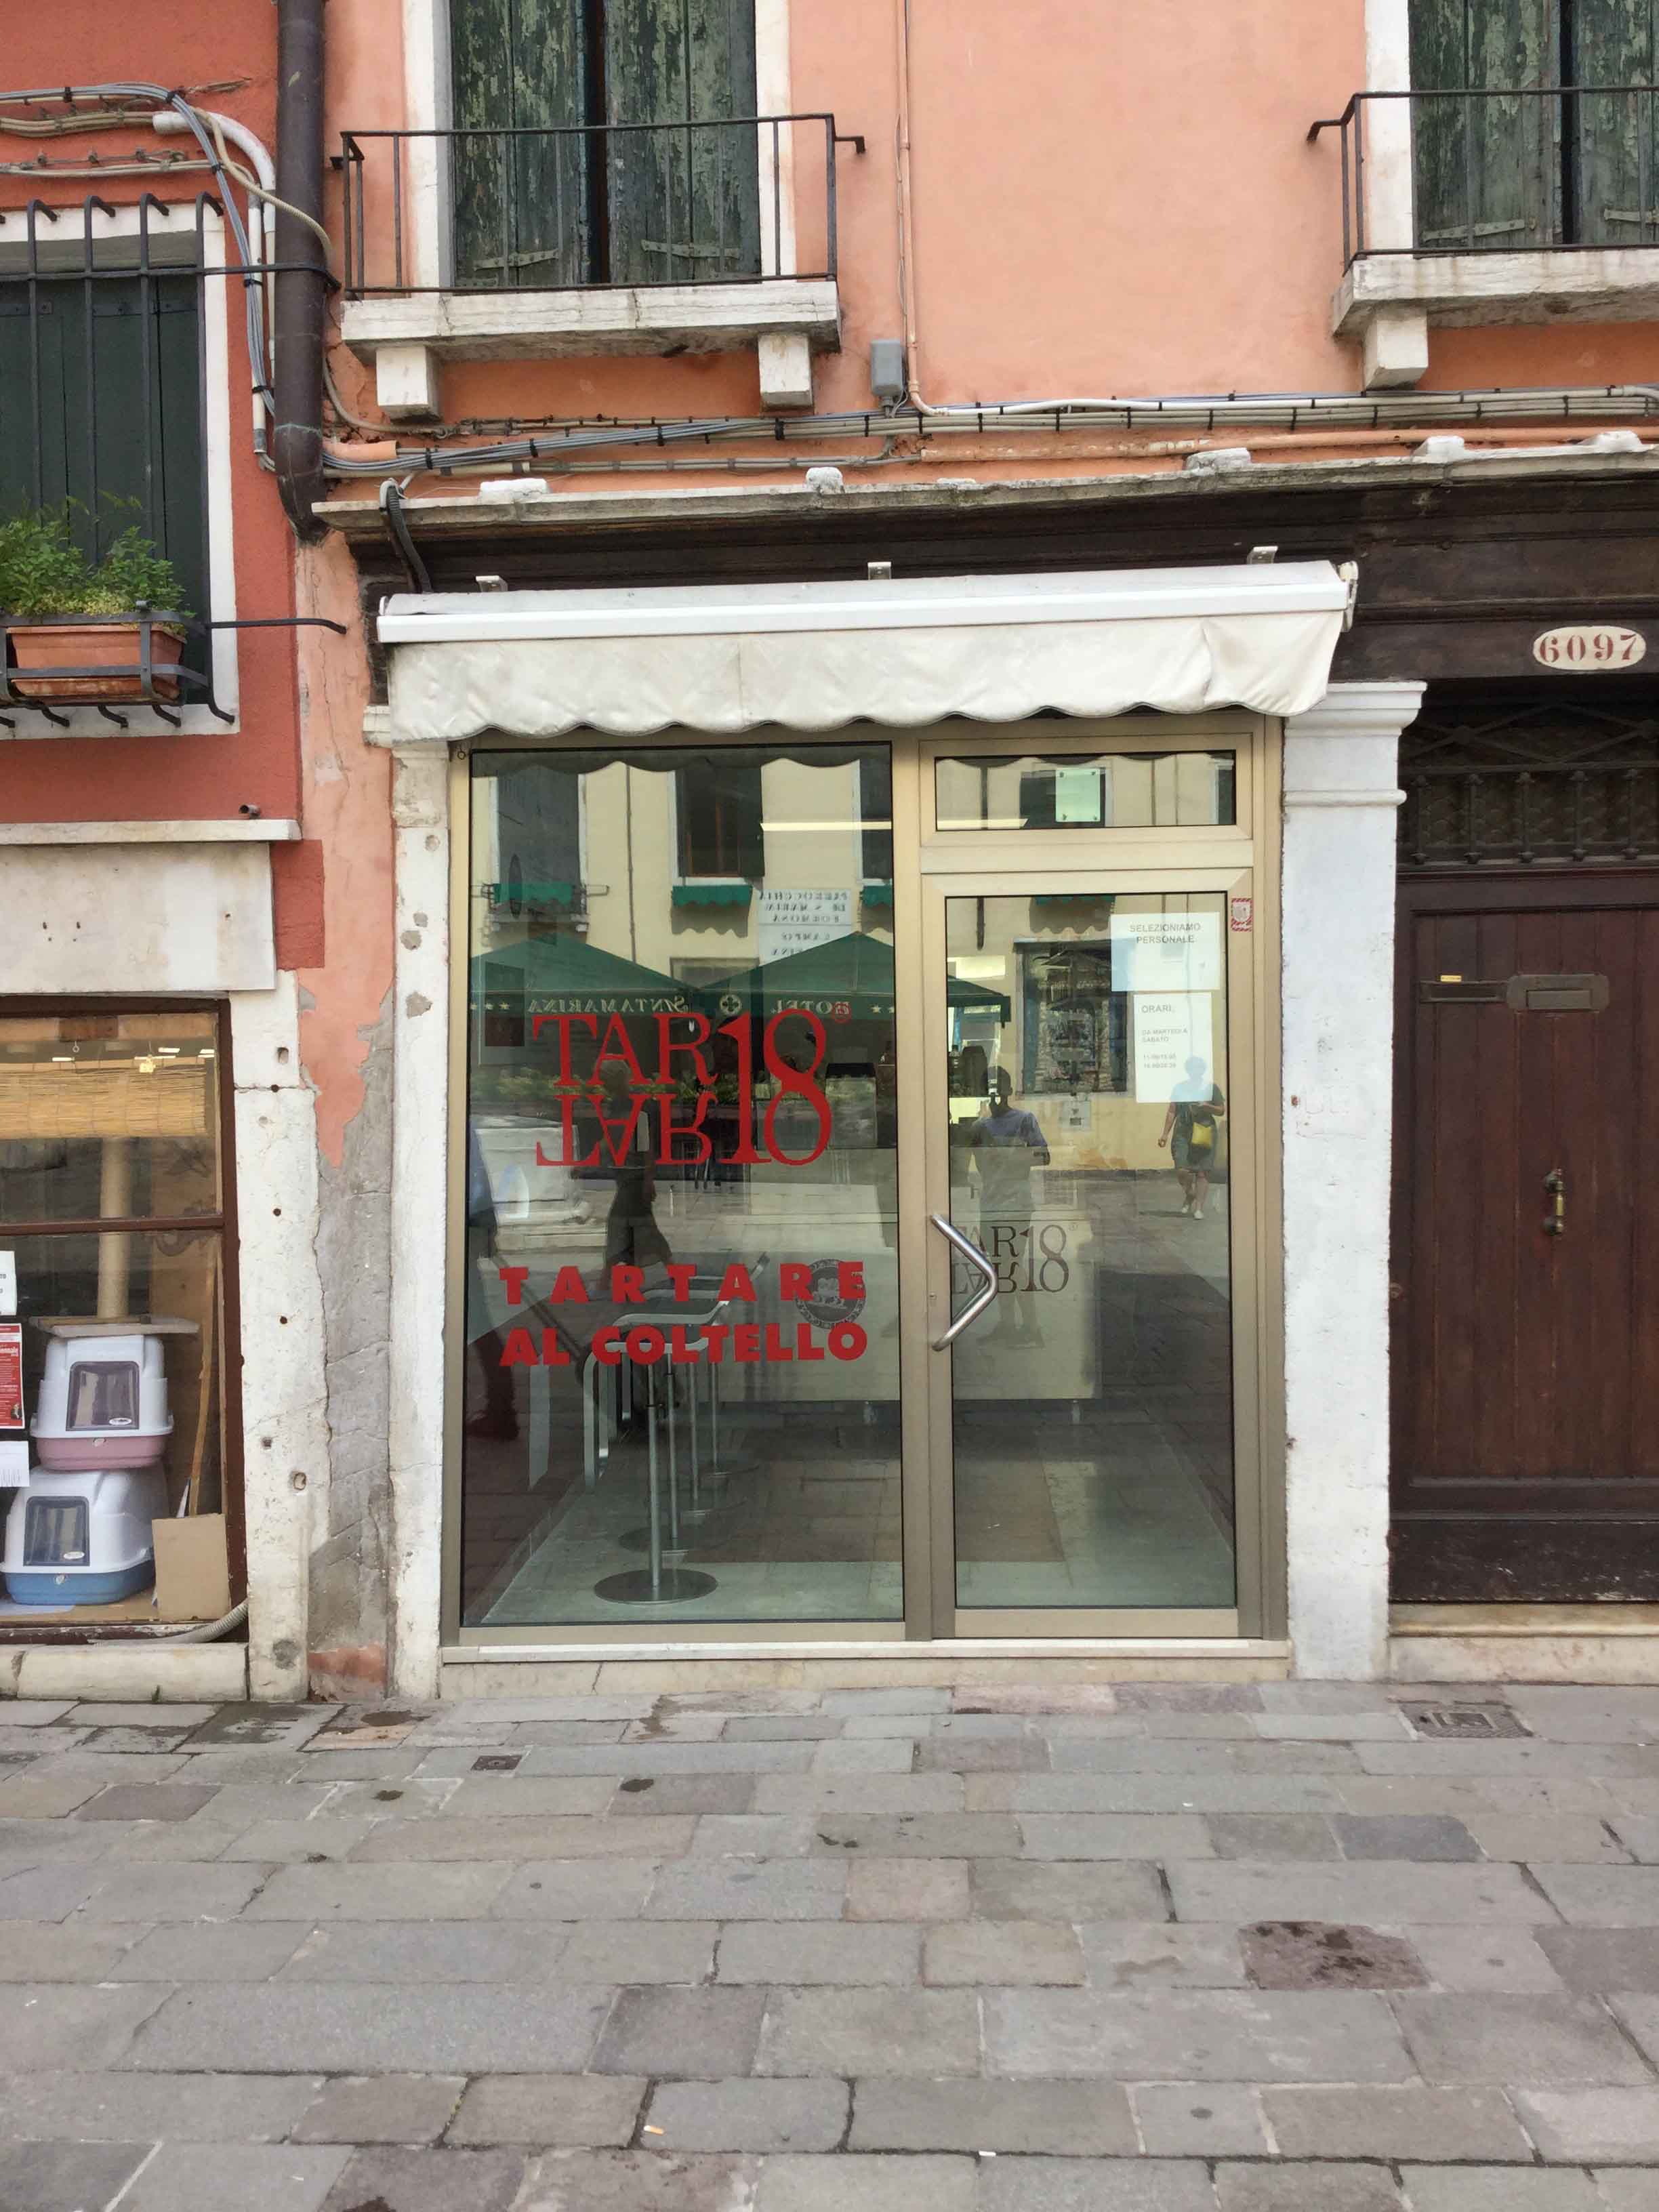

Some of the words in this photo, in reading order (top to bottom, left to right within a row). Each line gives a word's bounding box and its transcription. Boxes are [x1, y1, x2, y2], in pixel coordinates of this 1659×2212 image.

[1539, 634, 1638, 663] 6097
[1129, 922, 1201, 933] SELEZIONIAMO
[1136, 935, 1195, 944] PERSONALE
[499, 1261, 864, 1305] TARTARE
[499, 1328, 570, 1367] AL
[590, 1322, 867, 1366] COLTELLO
